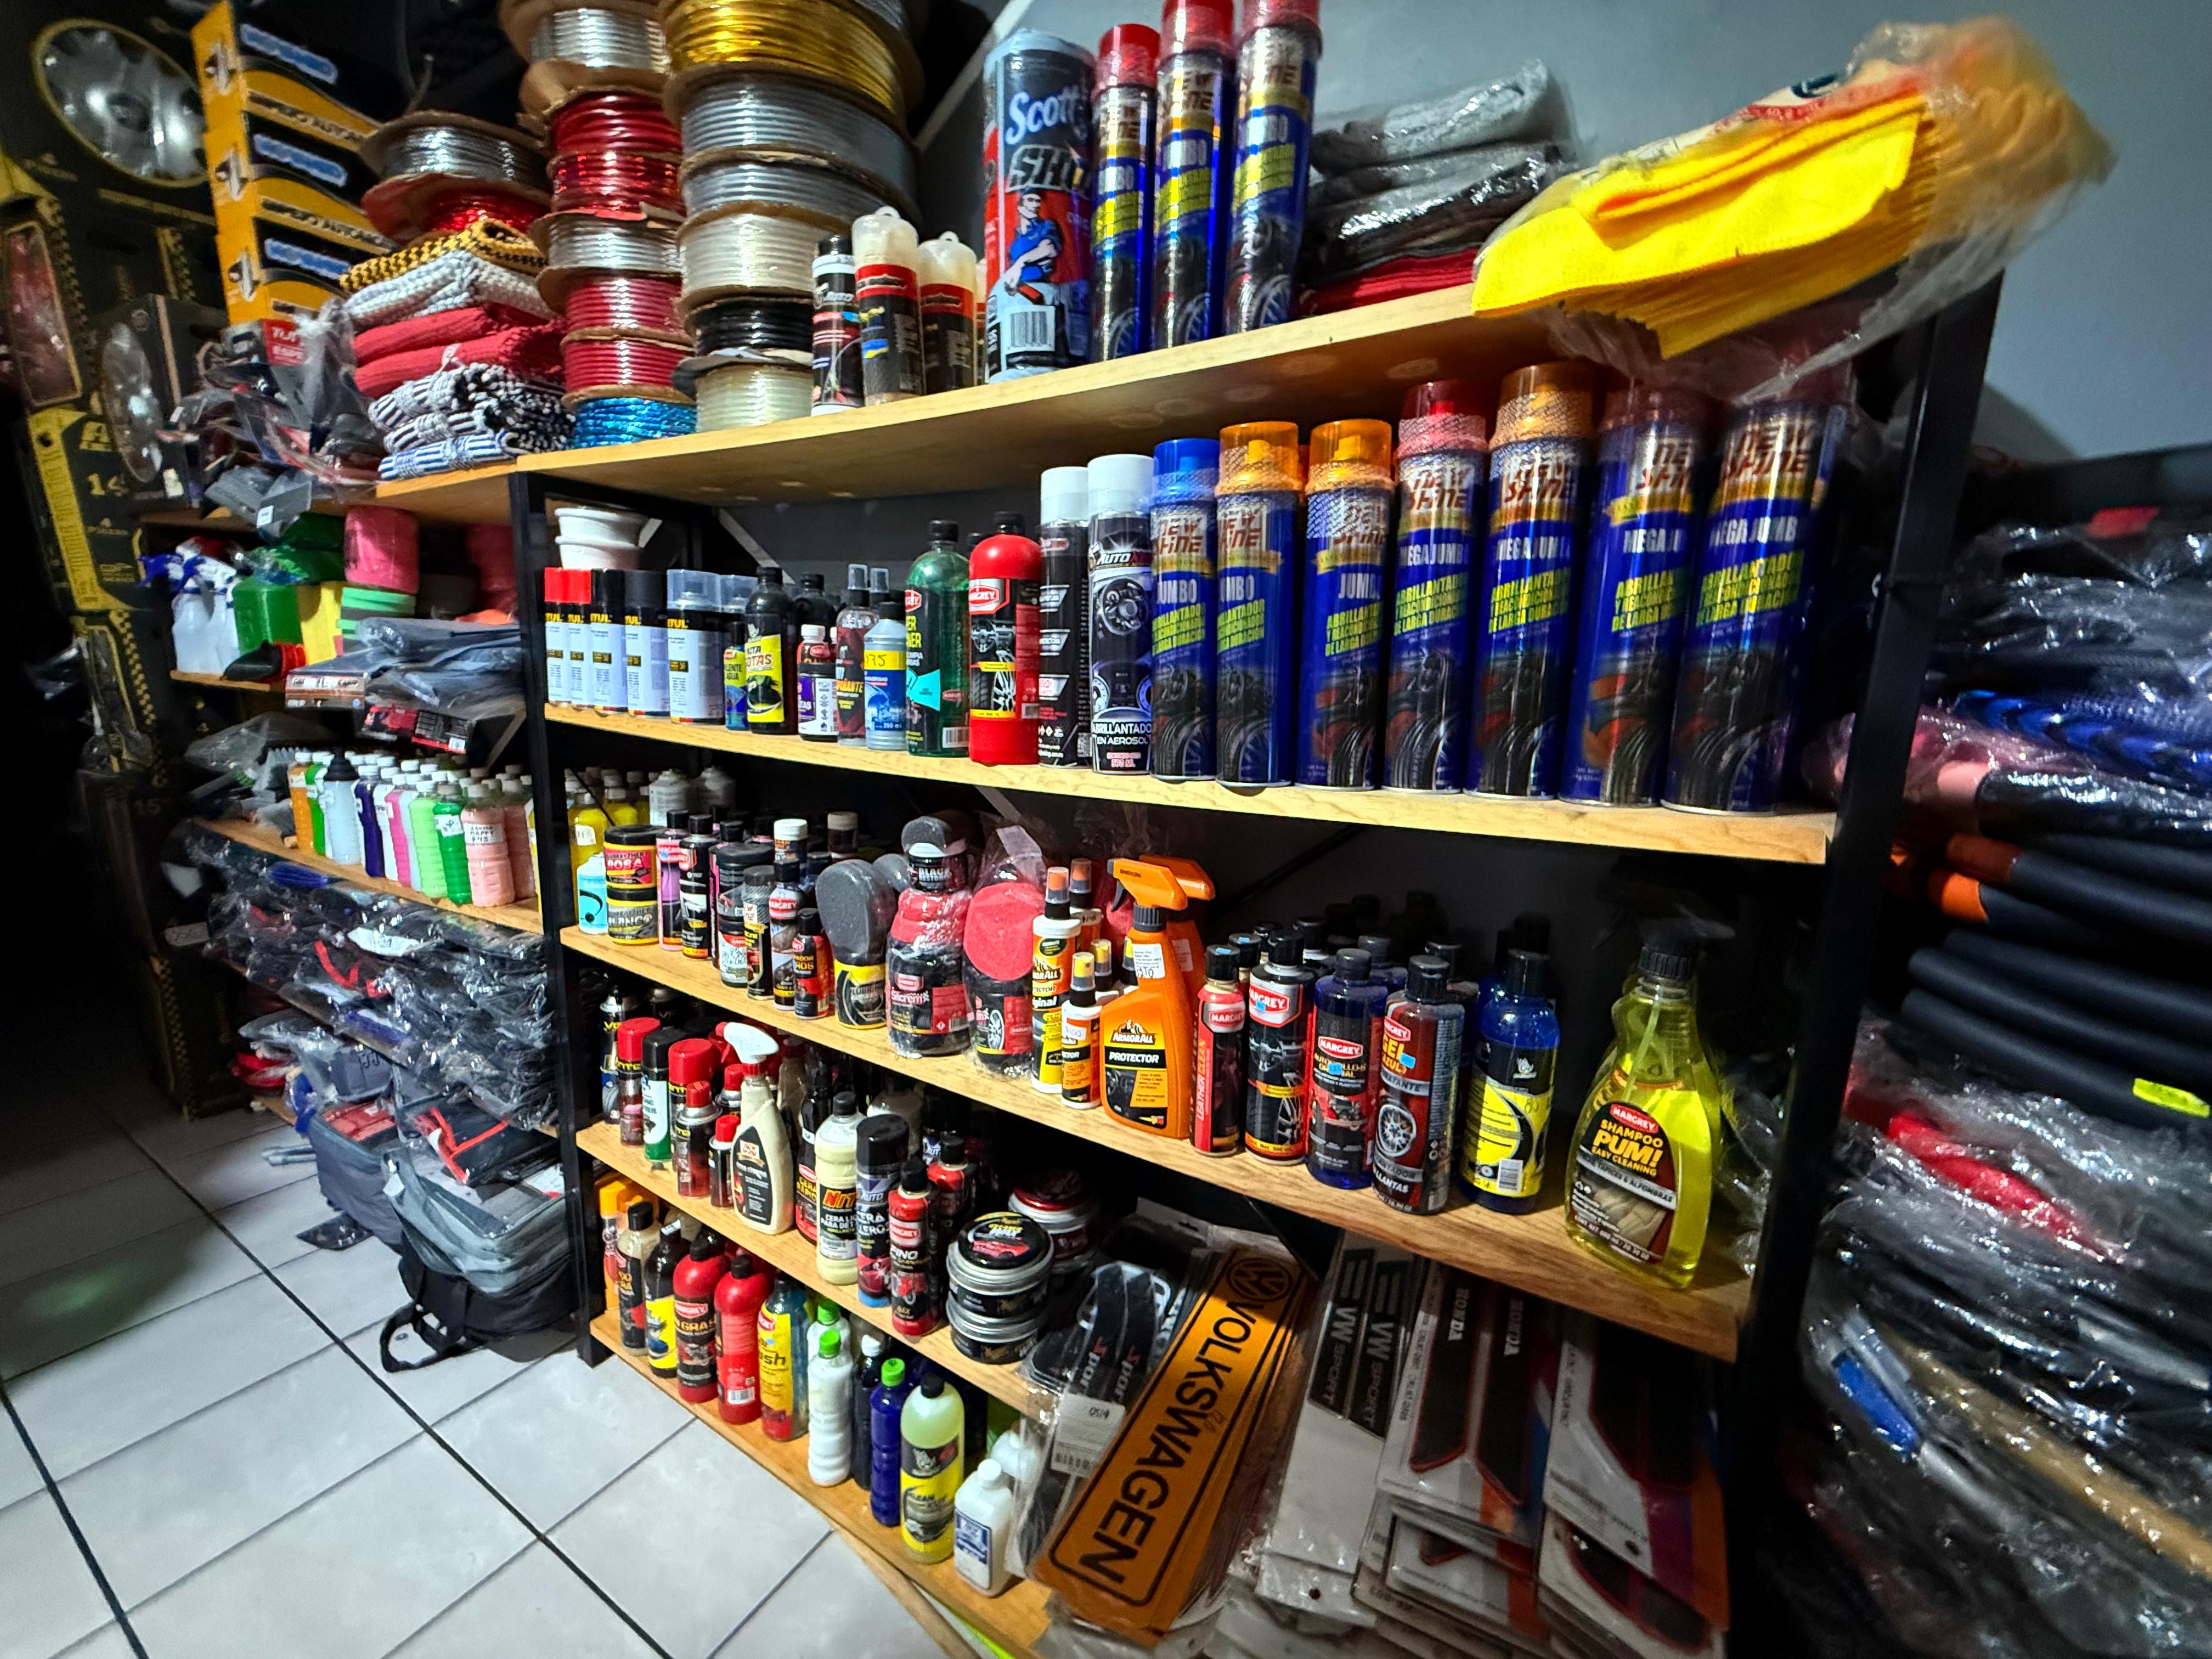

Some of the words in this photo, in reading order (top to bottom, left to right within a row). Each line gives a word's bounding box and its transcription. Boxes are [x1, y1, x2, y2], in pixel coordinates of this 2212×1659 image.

[1109, 1051, 1159, 1064] PROTECTOR
[1198, 1040, 1206, 1076] CLEAN
[1320, 1039, 1360, 1056] MARGREY
[1195, 1075, 1206, 1121] LEATHER
[1600, 1119, 1663, 1148] SHAMPOO
[1612, 1104, 1656, 1132] MARGREY
[1591, 1146, 1611, 1160] EASY
[1612, 1155, 1657, 1176] CLEANING
[1593, 1129, 1663, 1169] PUM!
[1628, 1177, 1674, 1203] ALFOMBRAS
[1330, 1307, 1359, 1343] VW
[1367, 1322, 1395, 1361] VW
[1079, 1301, 1258, 1584] VOLKSWAGEN
